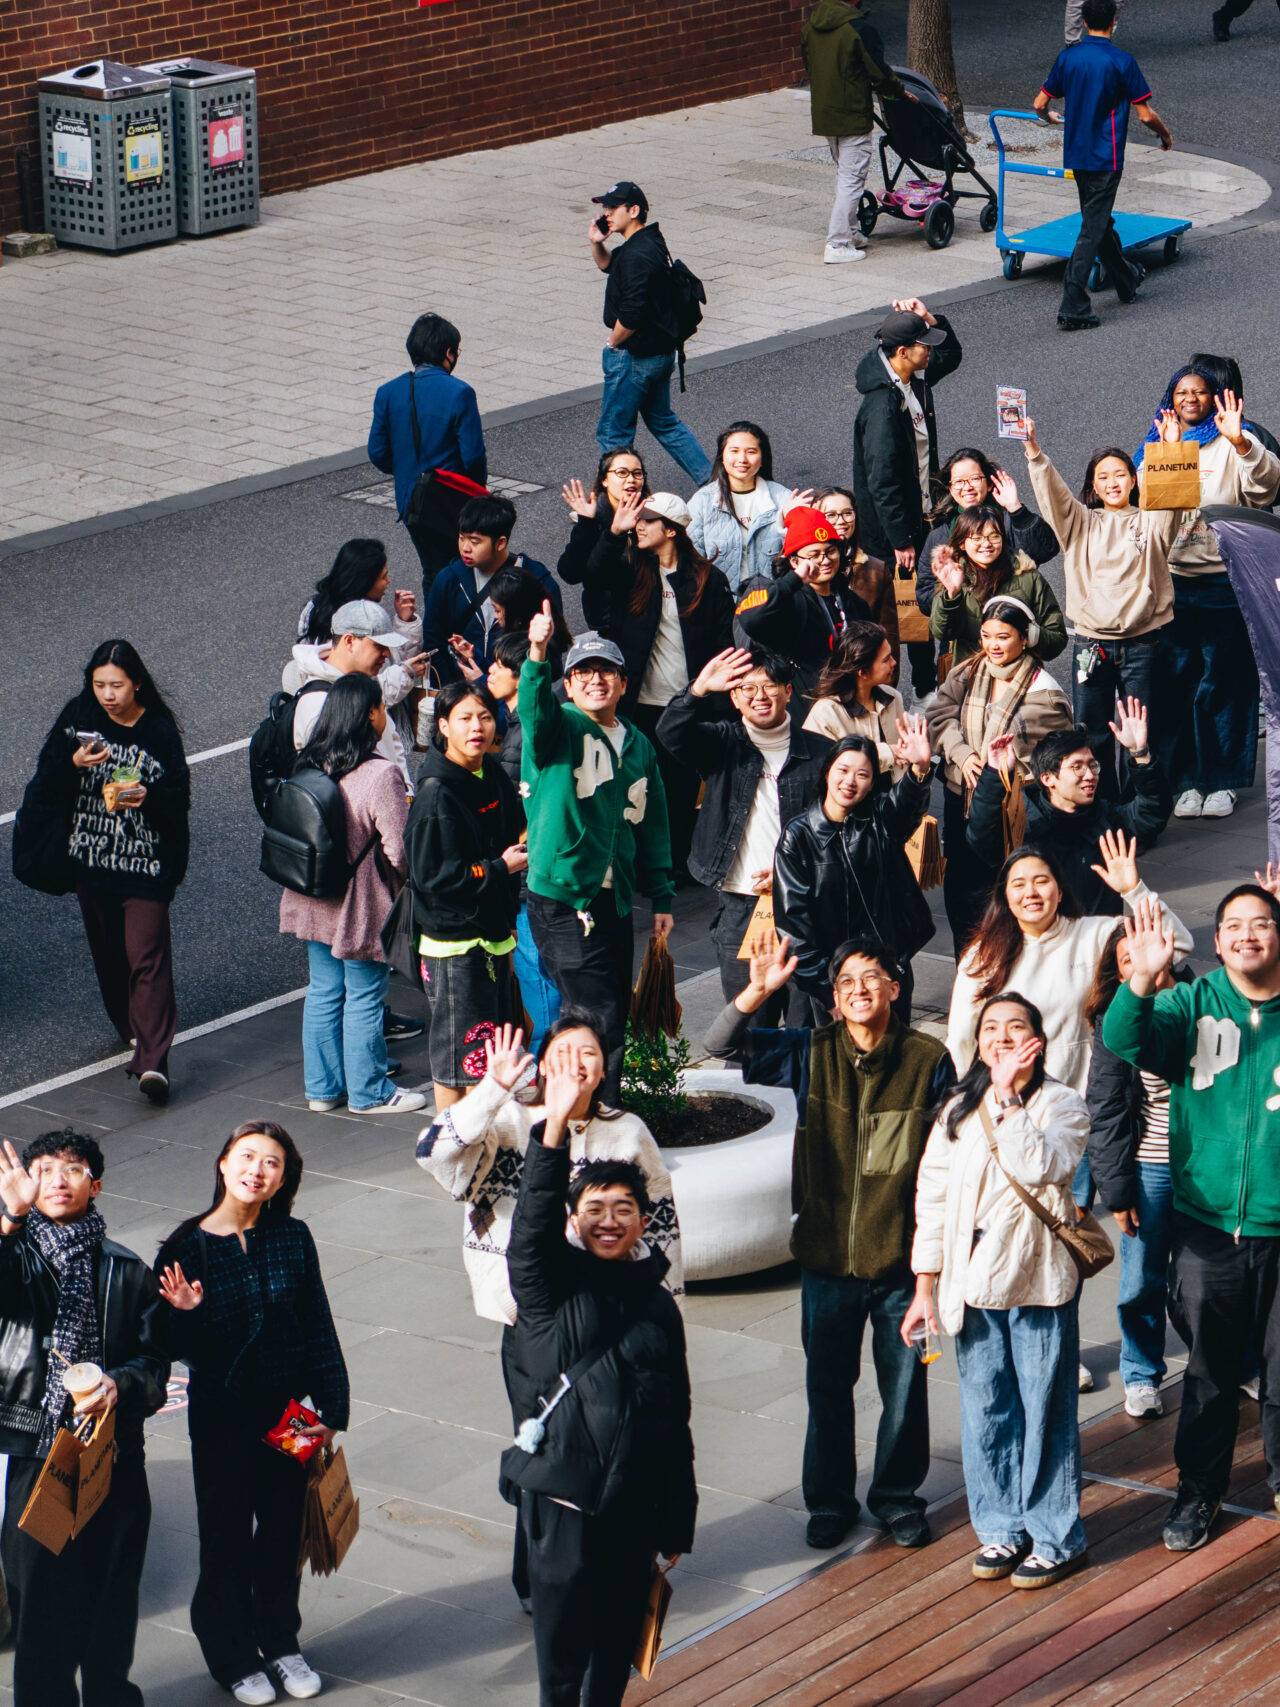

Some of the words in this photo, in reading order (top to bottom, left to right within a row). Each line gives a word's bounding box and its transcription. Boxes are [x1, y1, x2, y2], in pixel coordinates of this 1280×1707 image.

[63, 123, 88, 135] recycling
[134, 122, 159, 133] recycling
[1147, 462, 1199, 473] PLANETUNI
